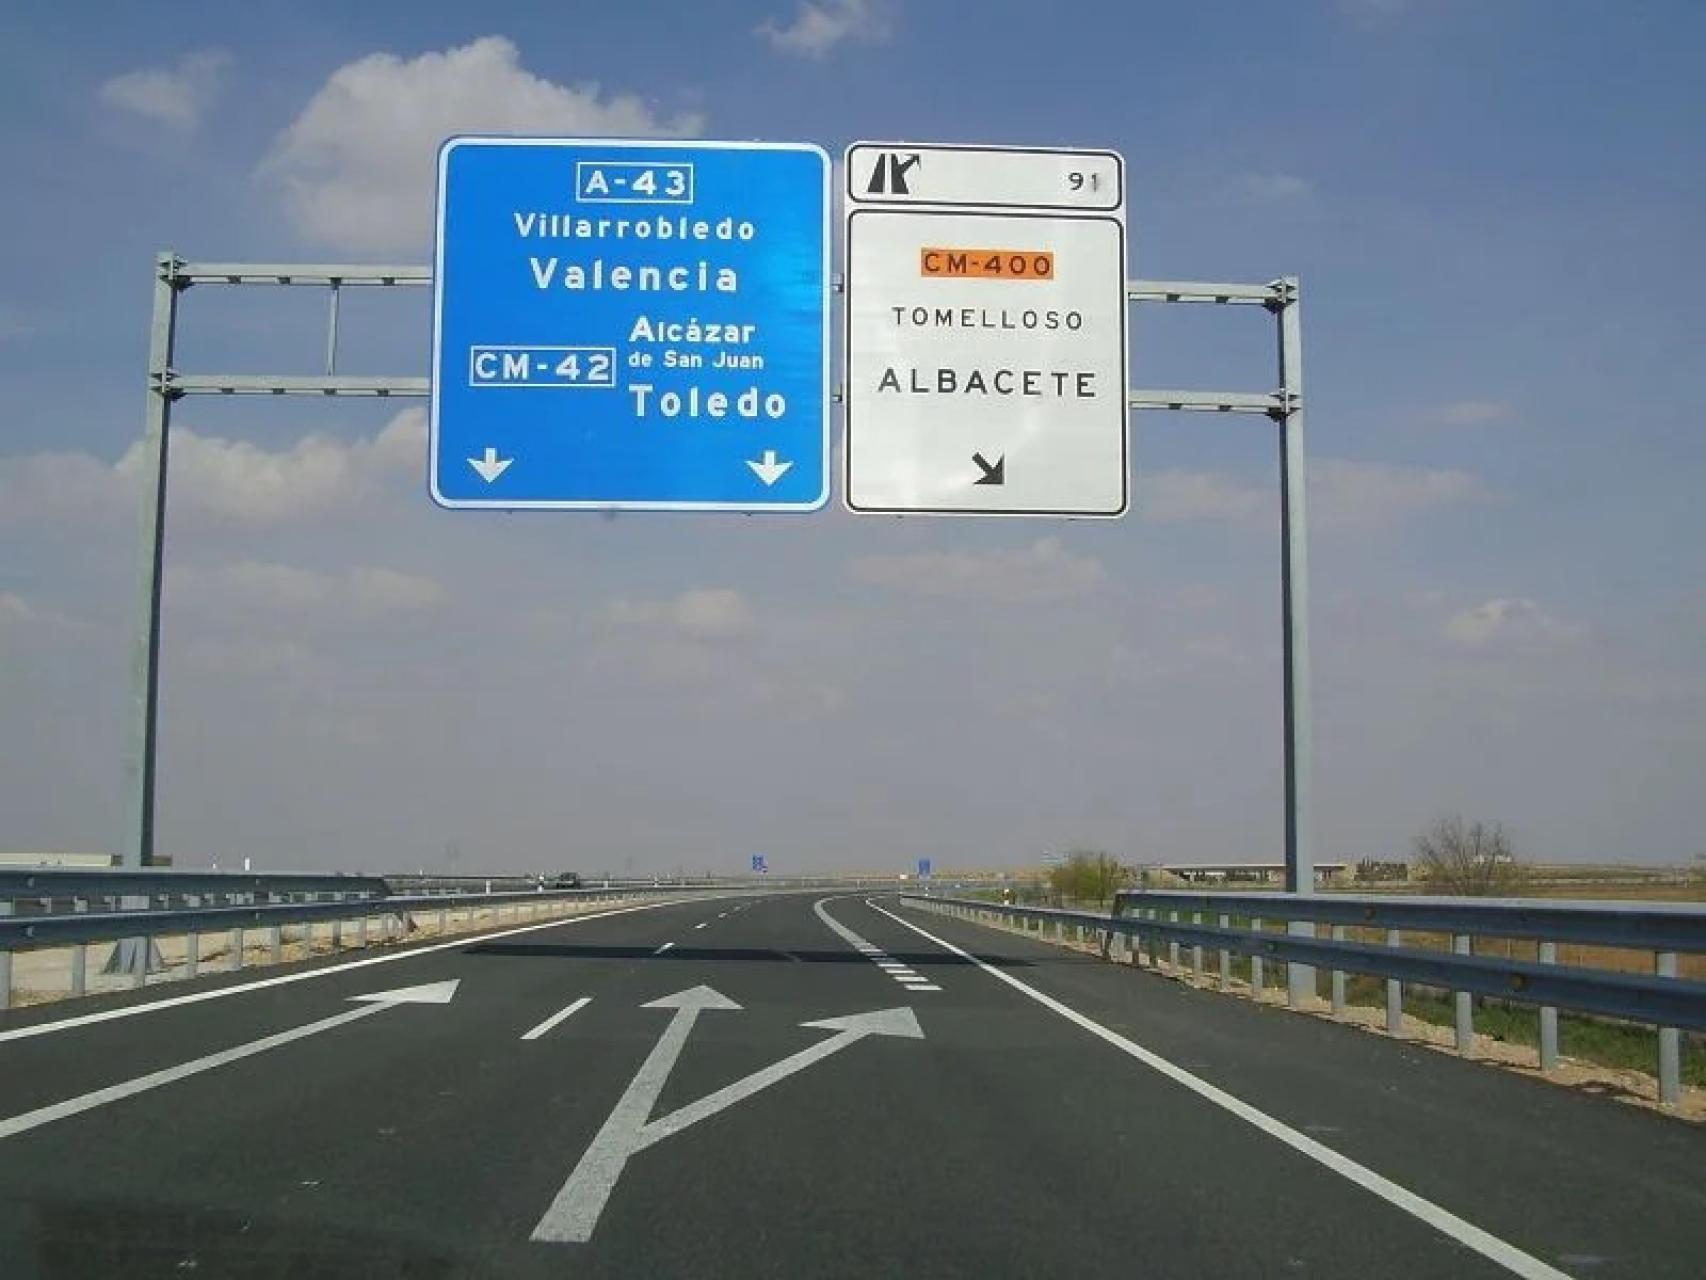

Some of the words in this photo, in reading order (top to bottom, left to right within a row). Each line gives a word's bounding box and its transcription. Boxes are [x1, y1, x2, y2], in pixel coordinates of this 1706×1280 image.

[585, 170, 686, 195] A-43
[1068, 172, 1099, 192] 91
[514, 213, 754, 240] Villarrobledo
[530, 258, 737, 292] Valencia
[924, 253, 1050, 276] CM-400
[629, 316, 756, 343] Alcázar
[892, 306, 1082, 330] TOMELLOSO
[475, 353, 610, 381] CM-42
[629, 352, 651, 368] de
[664, 351, 702, 368] San
[712, 351, 764, 369] Juan
[878, 368, 1096, 398] ALBACETE
[629, 384, 785, 418] Toledo
